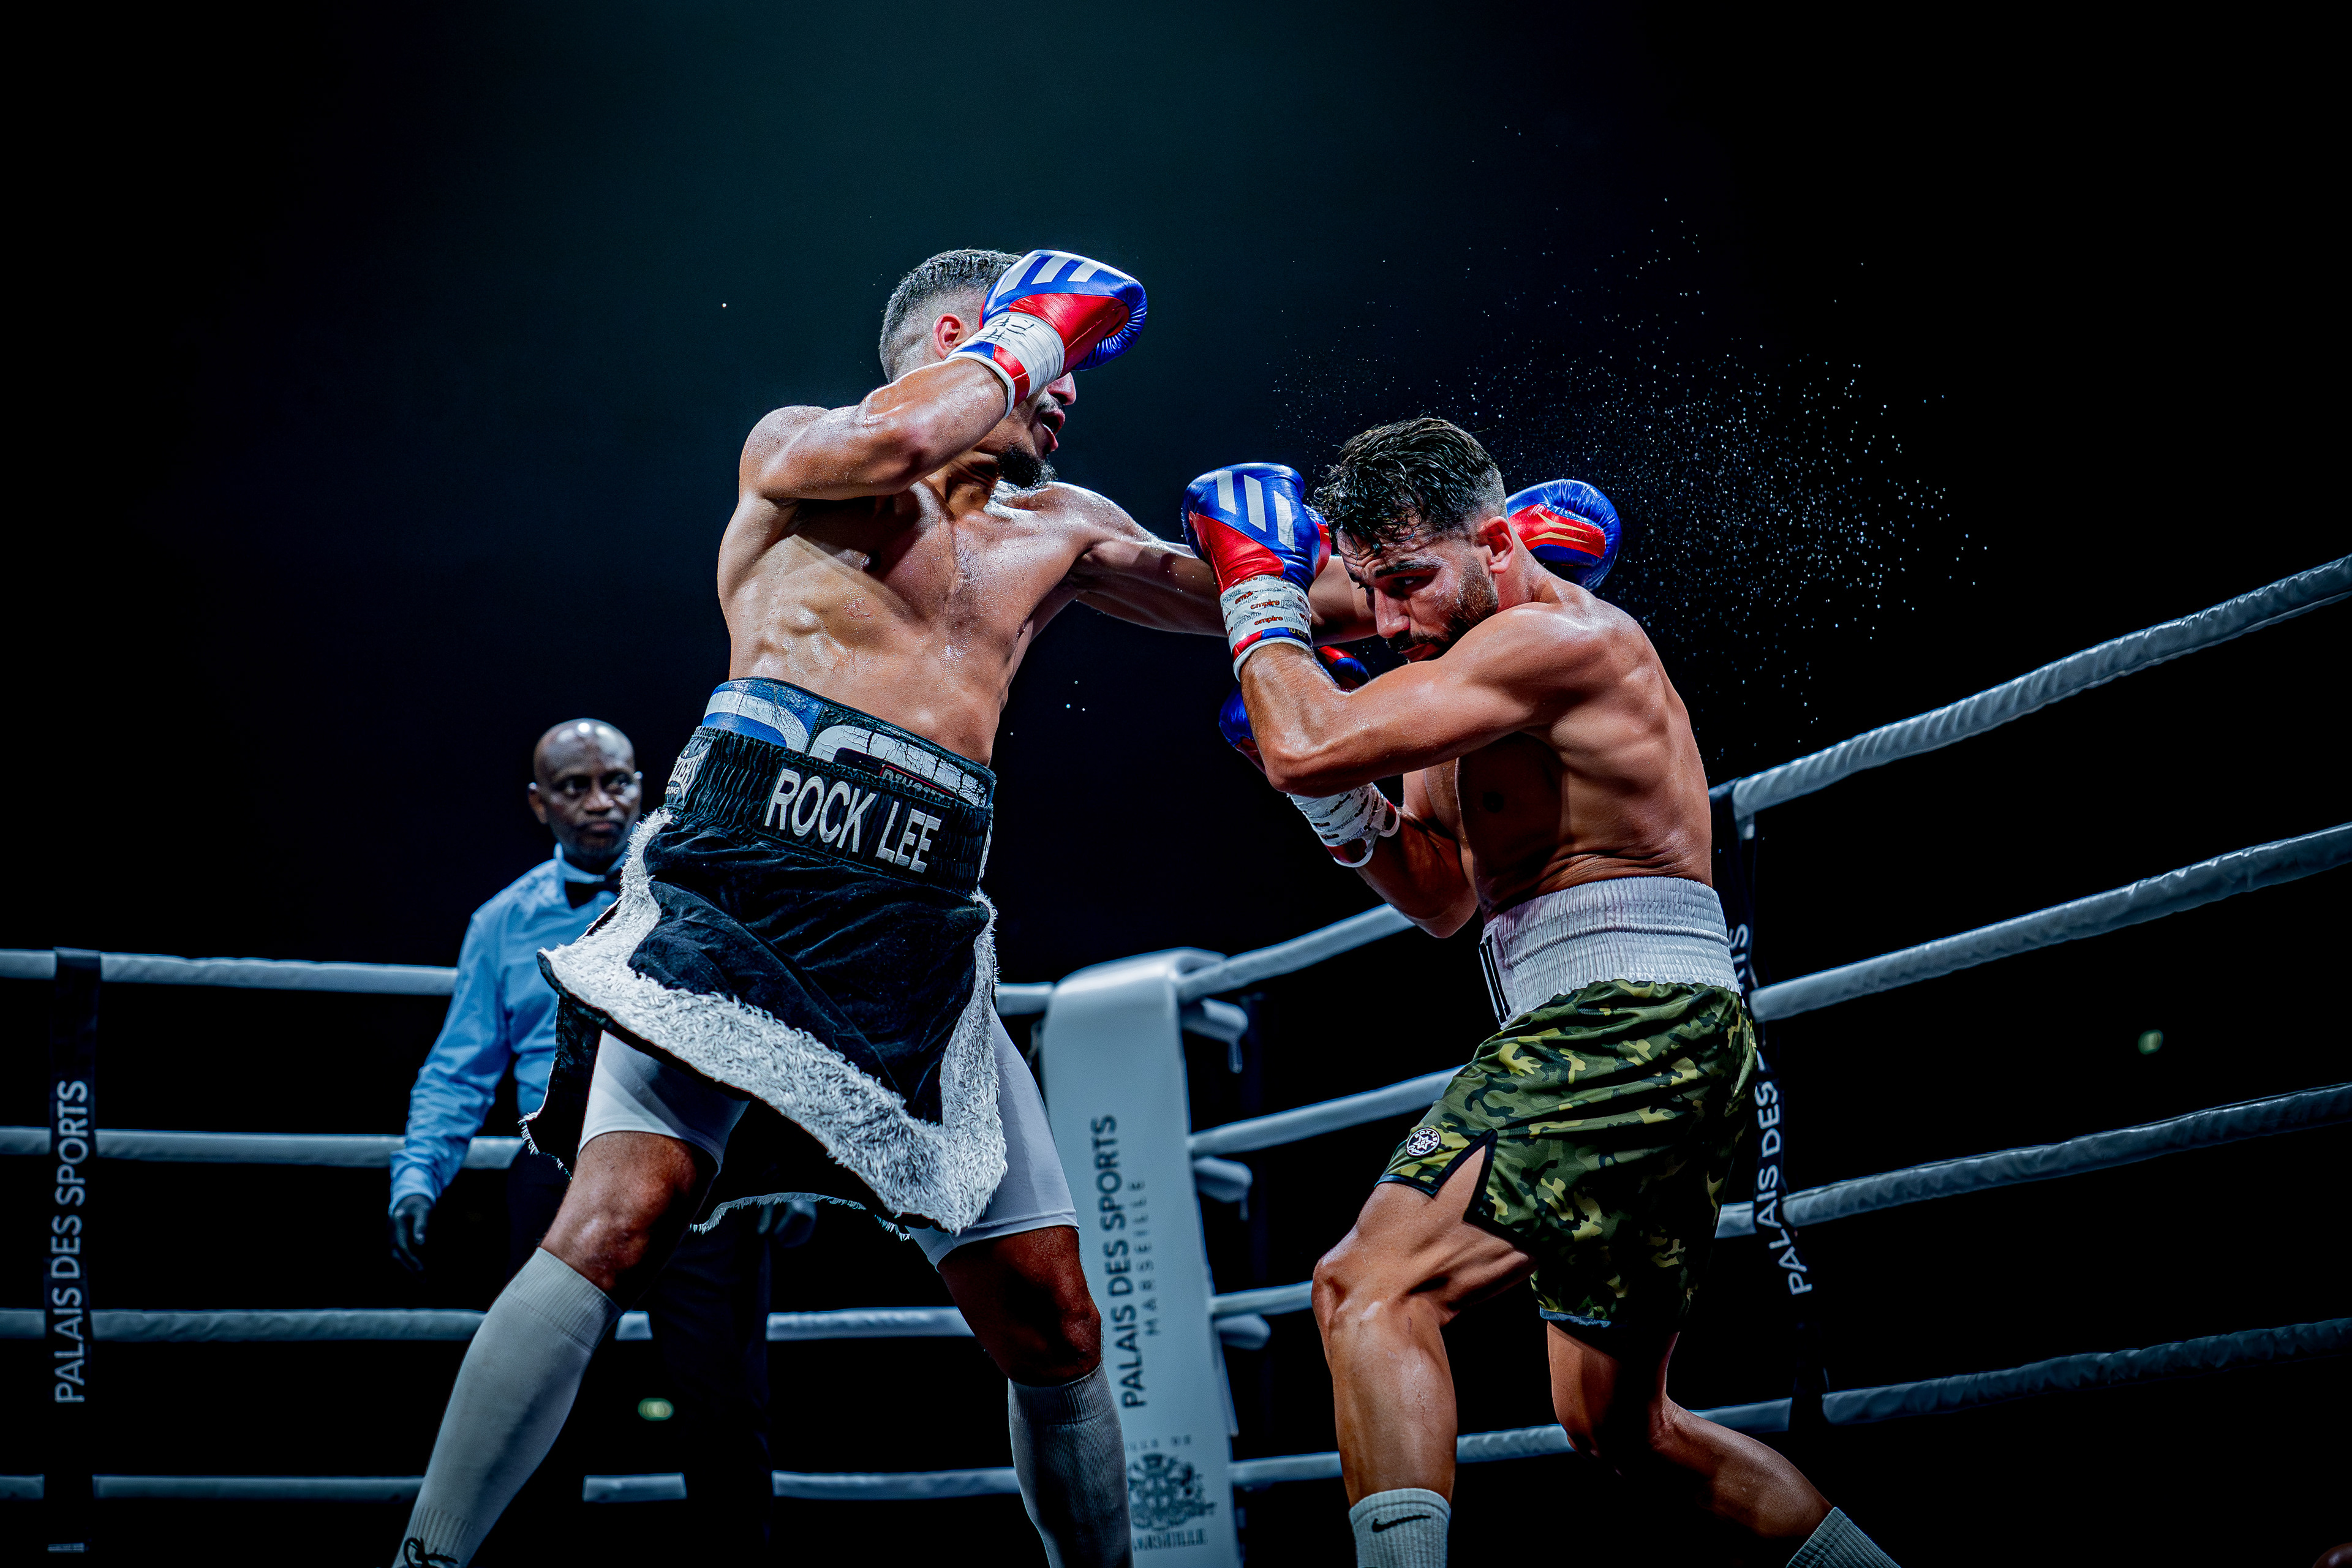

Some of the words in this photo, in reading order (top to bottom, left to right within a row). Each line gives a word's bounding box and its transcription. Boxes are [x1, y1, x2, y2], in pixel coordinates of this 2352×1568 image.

[1254, 616, 1283, 625] empire
[764, 768, 876, 853] ROCK
[875, 801, 942, 874] LEE
[54, 1080, 89, 1207] SPORTS
[1756, 1080, 1781, 1158] DES
[1091, 1114, 1126, 1231] SPORTS
[50, 1215, 83, 1280] DES
[1104, 1238, 1133, 1297] DES
[1128, 1180, 1160, 1337] MARSEILLE
[1757, 1164, 1812, 1295] PALAIS
[51, 1287, 86, 1404] PALAIS
[1110, 1303, 1147, 1409] PALAIS
